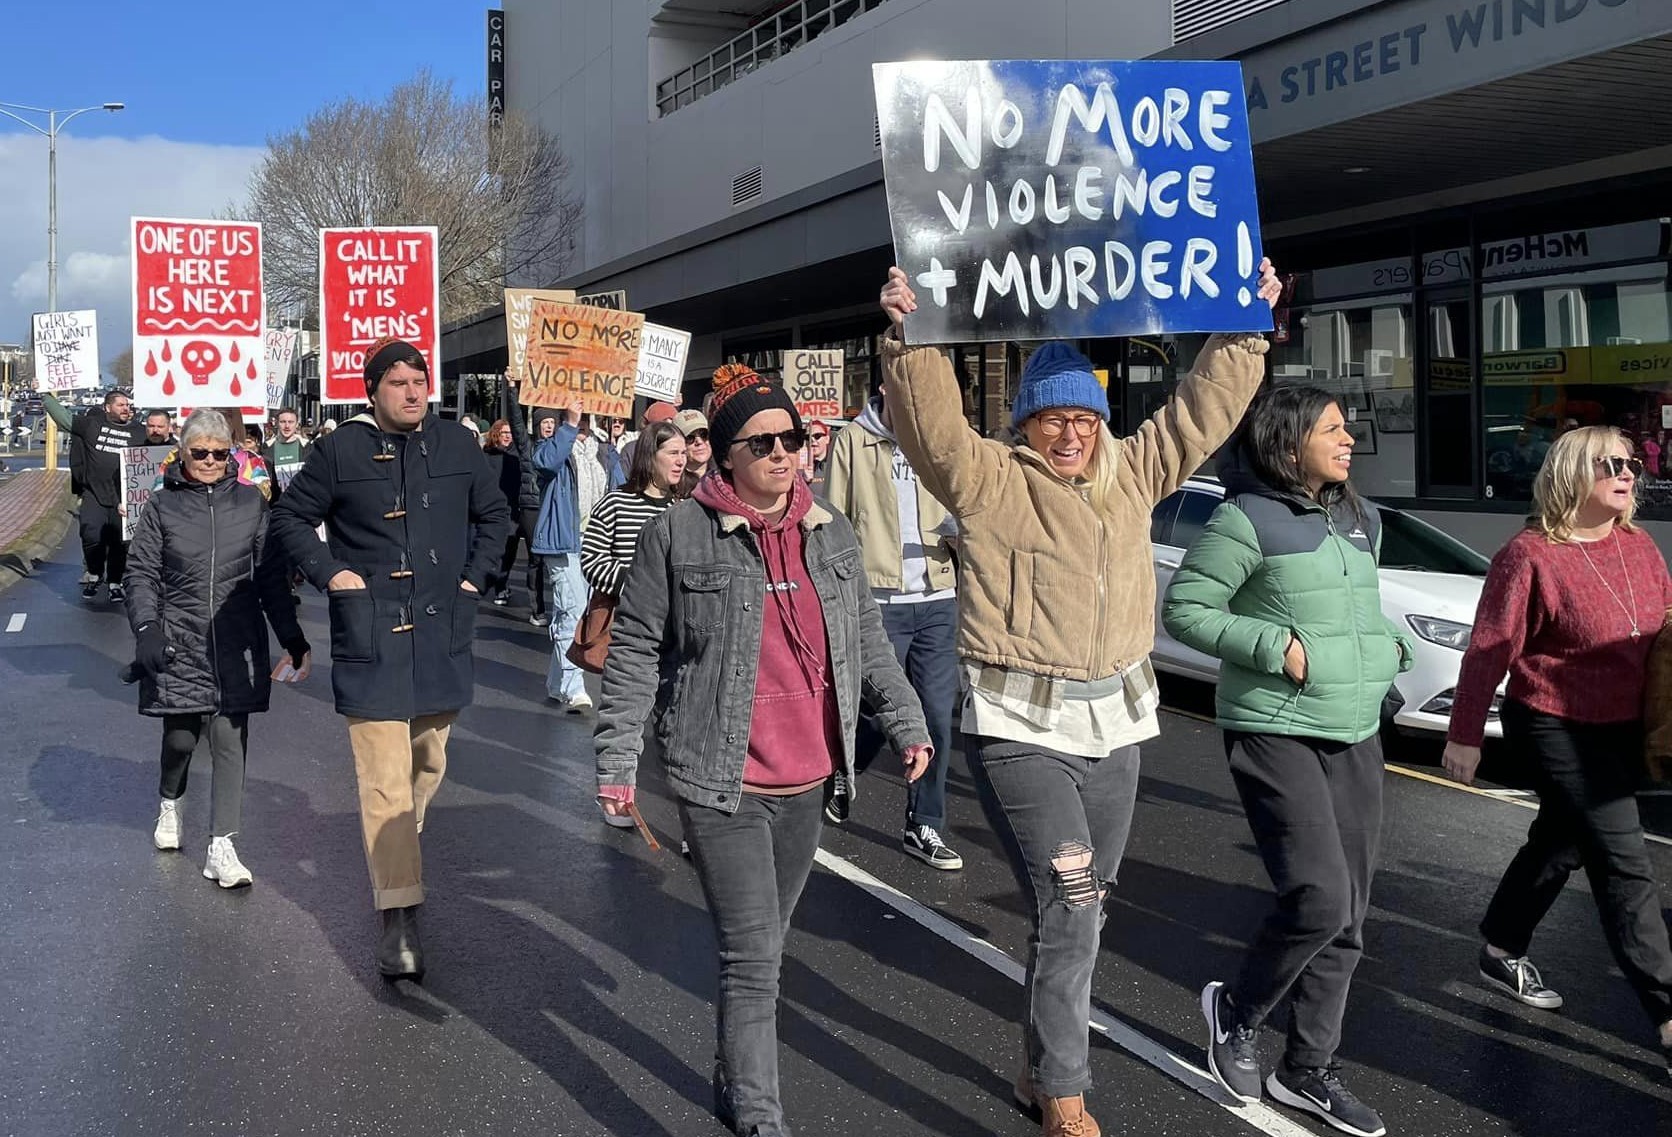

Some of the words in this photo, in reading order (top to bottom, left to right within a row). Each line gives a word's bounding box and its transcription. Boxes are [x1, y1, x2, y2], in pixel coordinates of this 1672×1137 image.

[490, 16, 502, 62] CAR
[1281, 24, 1427, 103] STREET
[1446, 0, 1631, 53] WIND
[490, 80, 502, 127] PAR
[923, 86, 1024, 172] NO
[1045, 82, 1233, 167] MORE
[937, 165, 1217, 235] VIOLENCE
[140, 225, 185, 254] ONE
[189, 228, 216, 256] OF
[222, 230, 253, 256] US
[337, 239, 393, 261] CALL
[397, 240, 422, 263] IT
[168, 258, 230, 286] HERE
[347, 265, 408, 285] WHAT
[148, 286, 174, 314] IS
[183, 288, 254, 314] NEXT
[349, 289, 367, 307] IT
[376, 288, 396, 308] IS
[39, 312, 78, 329] GIRLS
[36, 329, 57, 341] JUST
[61, 325, 93, 340] WANT
[541, 317, 579, 340] NO
[590, 323, 639, 351] MORE
[649, 333, 681, 358] MANY
[48, 363, 82, 376] FEEL
[795, 353, 841, 369] CALL
[48, 375, 80, 389] SAFE
[528, 361, 631, 399] VIOLENCE
[796, 370, 839, 386] OUT
[791, 386, 838, 401] YOUR
[123, 448, 149, 463] HER
[127, 489, 150, 502] OUR
